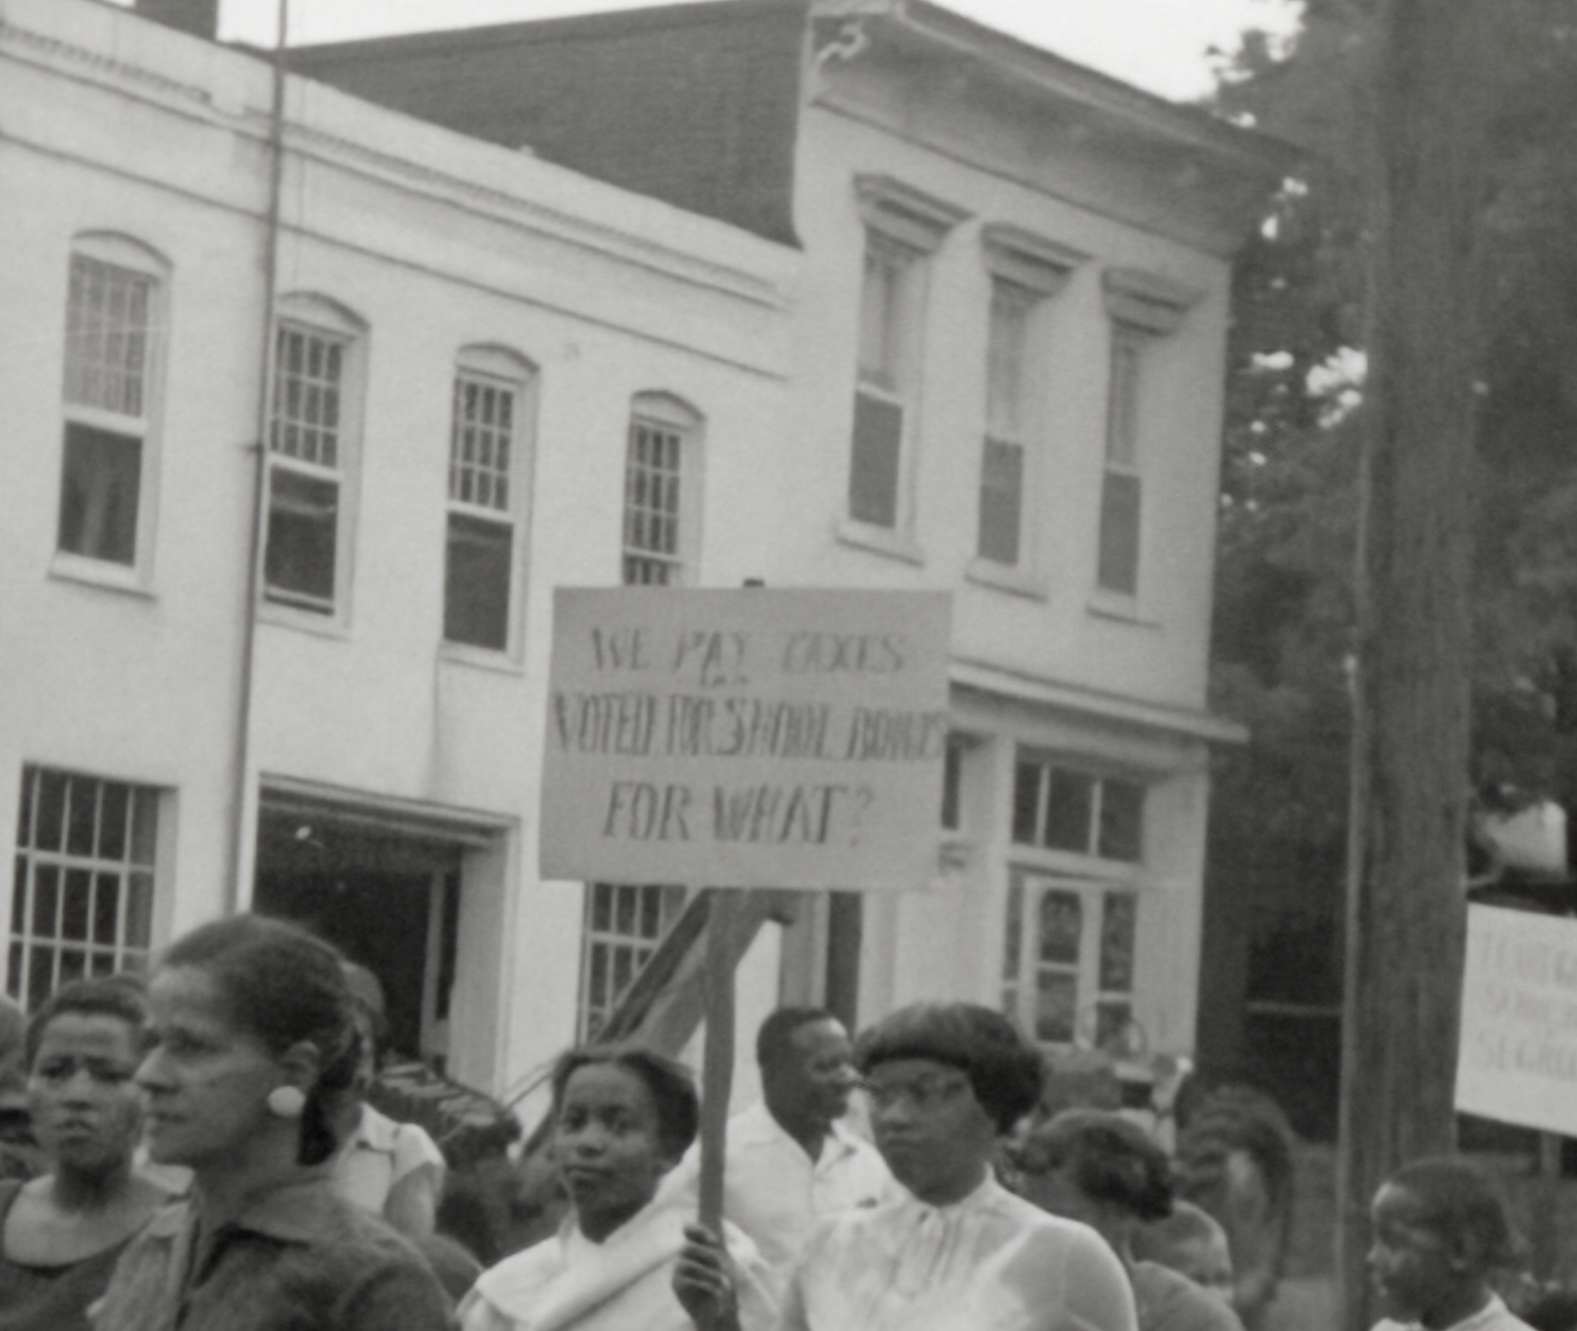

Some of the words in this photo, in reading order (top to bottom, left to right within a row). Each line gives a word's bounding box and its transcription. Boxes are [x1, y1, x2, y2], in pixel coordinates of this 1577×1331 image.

[591, 627, 651, 672] WE
[603, 781, 693, 842] FOR
[711, 782, 875, 848] WHAT?
